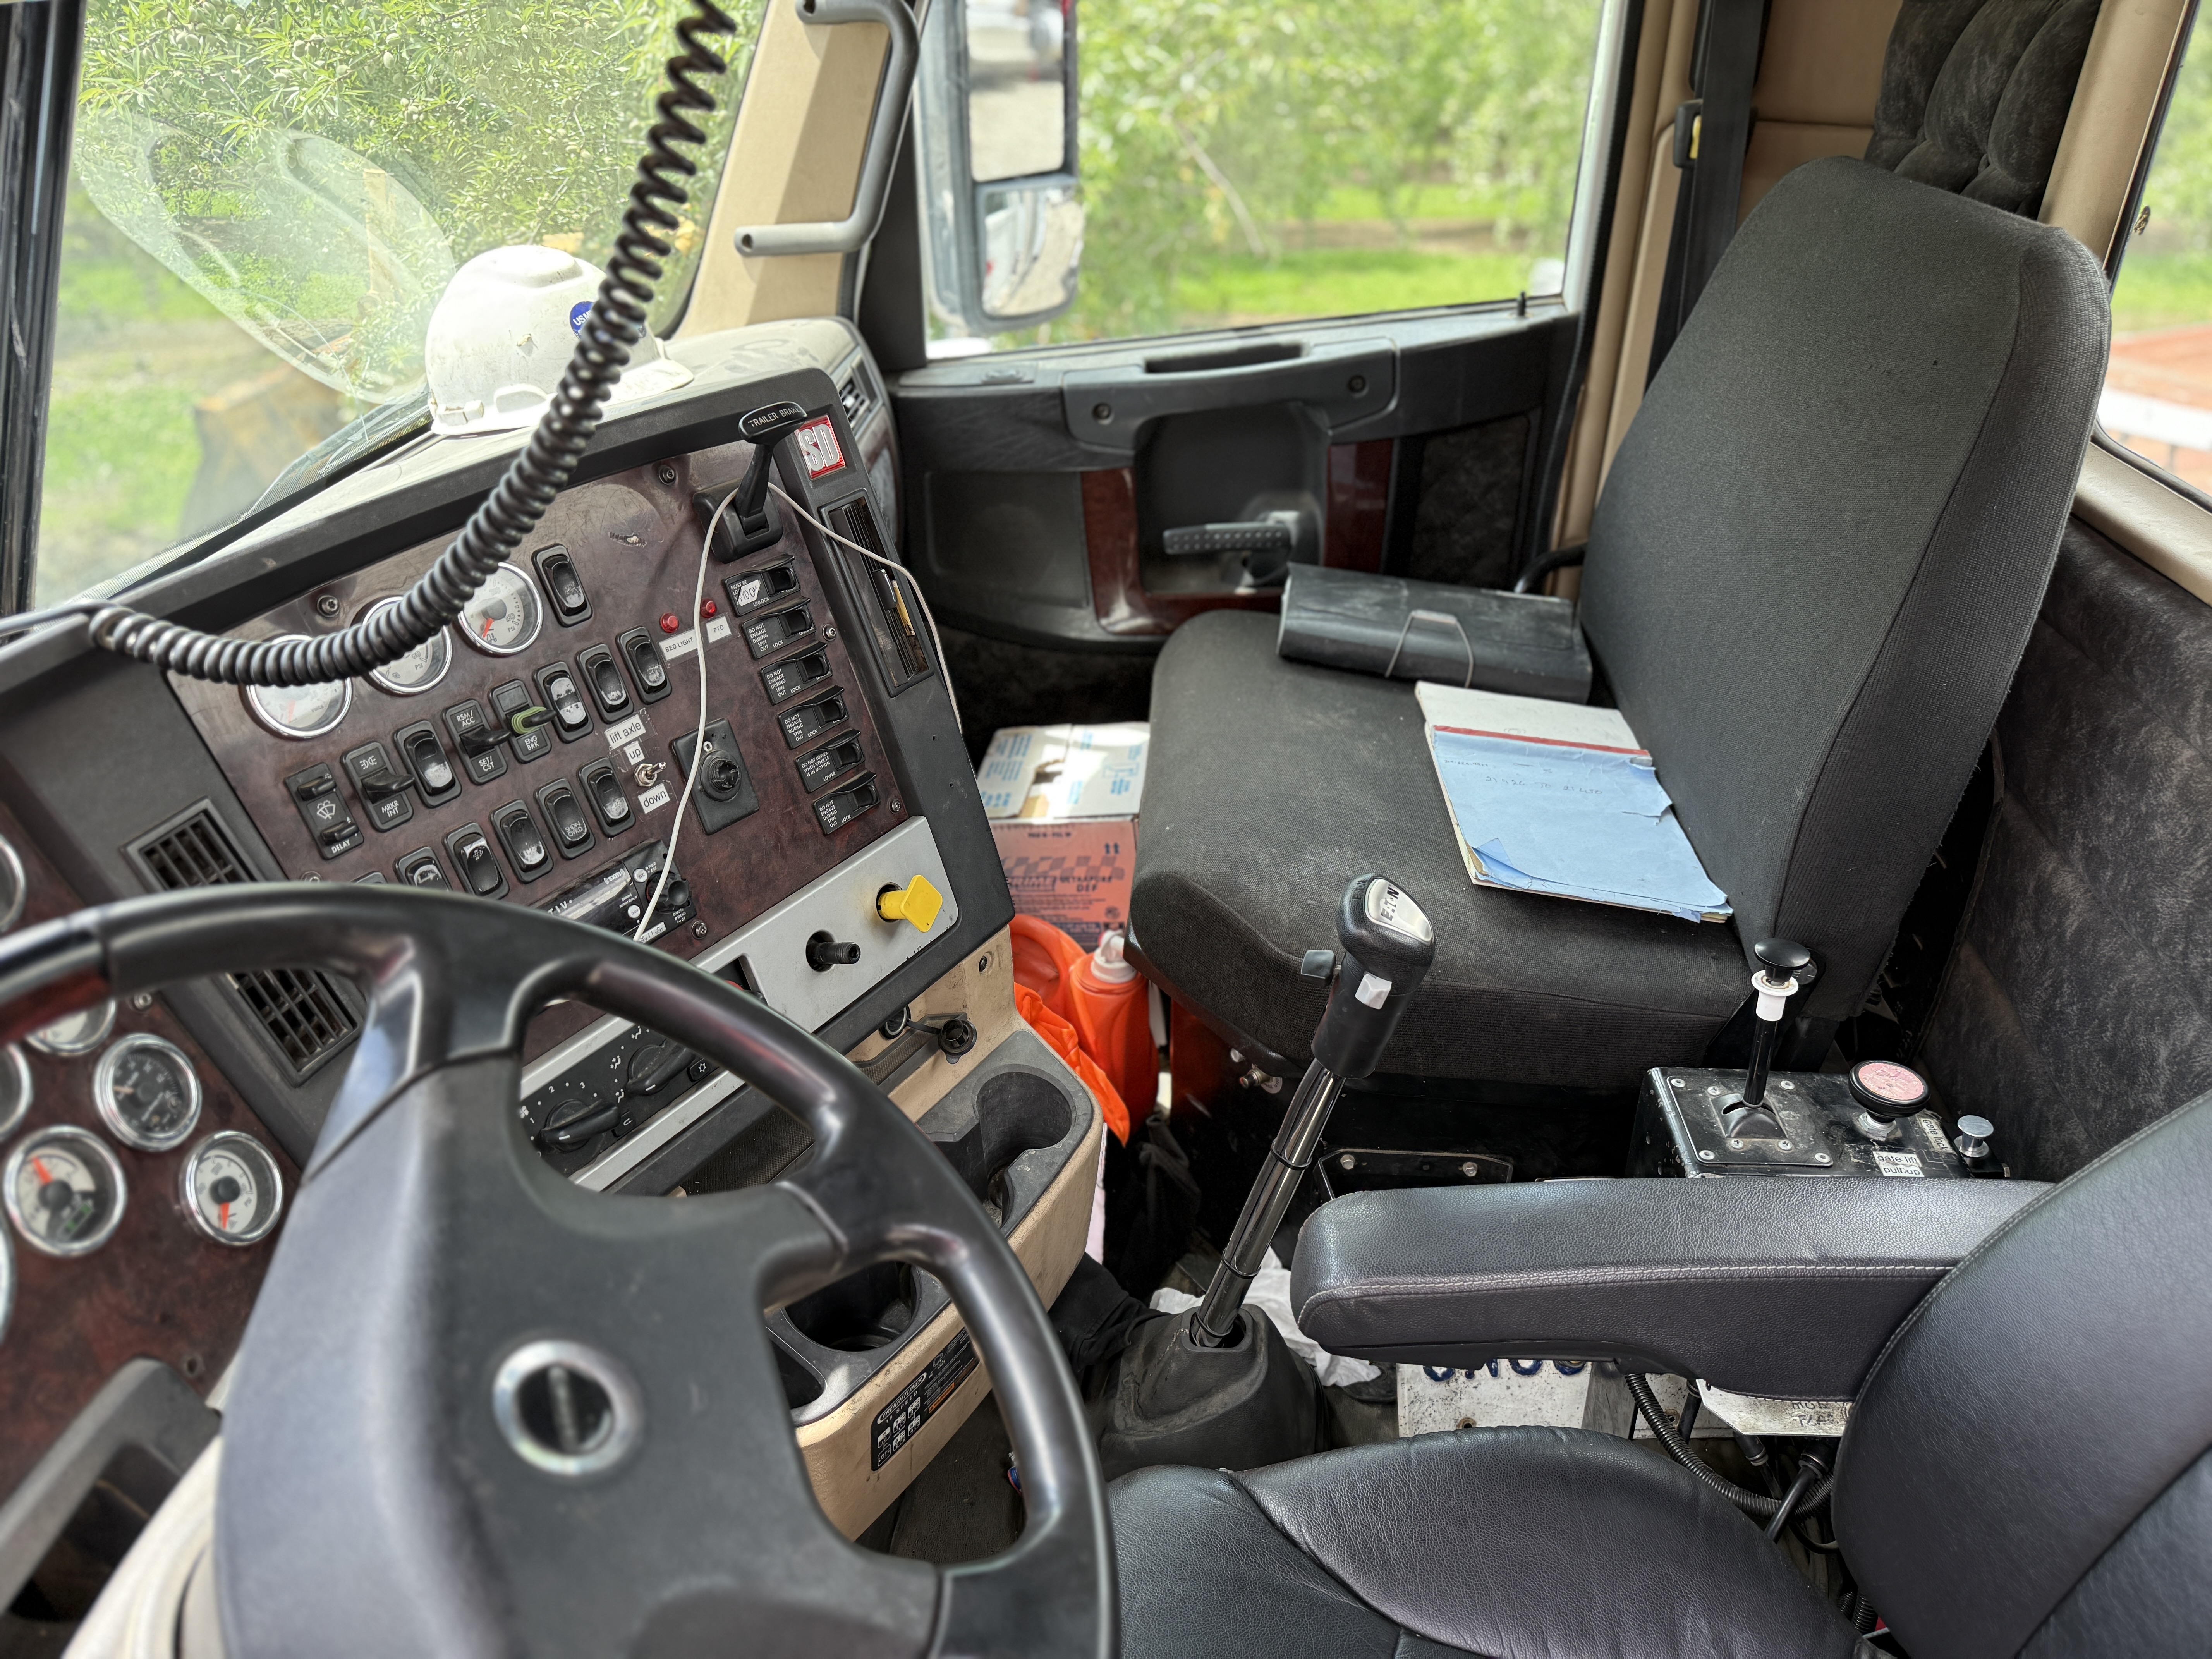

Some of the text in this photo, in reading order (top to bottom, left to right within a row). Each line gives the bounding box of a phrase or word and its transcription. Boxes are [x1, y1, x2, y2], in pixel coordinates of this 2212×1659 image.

[748, 406, 801, 427] TRAILER BRAKE
[798, 424, 840, 471] SD
[731, 582, 742, 590] MUST
[753, 596, 770, 606] UNLOCK
[713, 625, 724, 633] PTO
[750, 628, 767, 639] ENGAGE
[665, 637, 694, 652] BED LIGHT
[752, 634, 768, 644] DURING
[773, 640, 784, 648] LOCK
[768, 674, 785, 684] ENGAGE
[771, 679, 786, 689] DURING
[790, 685, 801, 693] LOCK
[456, 710, 473, 722] RSM/
[462, 717, 475, 727] ACC
[786, 718, 802, 729] ENGAGE
[609, 722, 641, 743] lift axle
[788, 723, 803, 734] DURING
[807, 729, 818, 738] LOCK
[524, 735, 537, 745] ENG
[527, 741, 539, 750] BRK
[629, 749, 641, 759] up
[816, 751, 829, 761] LOWER
[479, 756, 492, 766] SET/
[483, 761, 494, 771] CST
[804, 756, 830, 773] WHEN VEHICLE
[815, 761, 831, 773] MOTION
[823, 771, 836, 781] LOWER
[643, 790, 666, 807] down
[381, 800, 399, 813] MRKR
[387, 807, 398, 817] INT
[821, 805, 836, 816] ENGAGE
[823, 810, 837, 821] DURING
[841, 814, 851, 823] LOCK
[565, 821, 581, 832] SHDN
[568, 826, 583, 837] OVRD
[331, 839, 350, 853] DELAY
[1381, 886, 1399, 921] EATON
[1923, 1119, 1949, 1151] gate lock
[880, 1377, 923, 1419] FREIGHTLINER
[896, 1391, 917, 1413] SPEED
